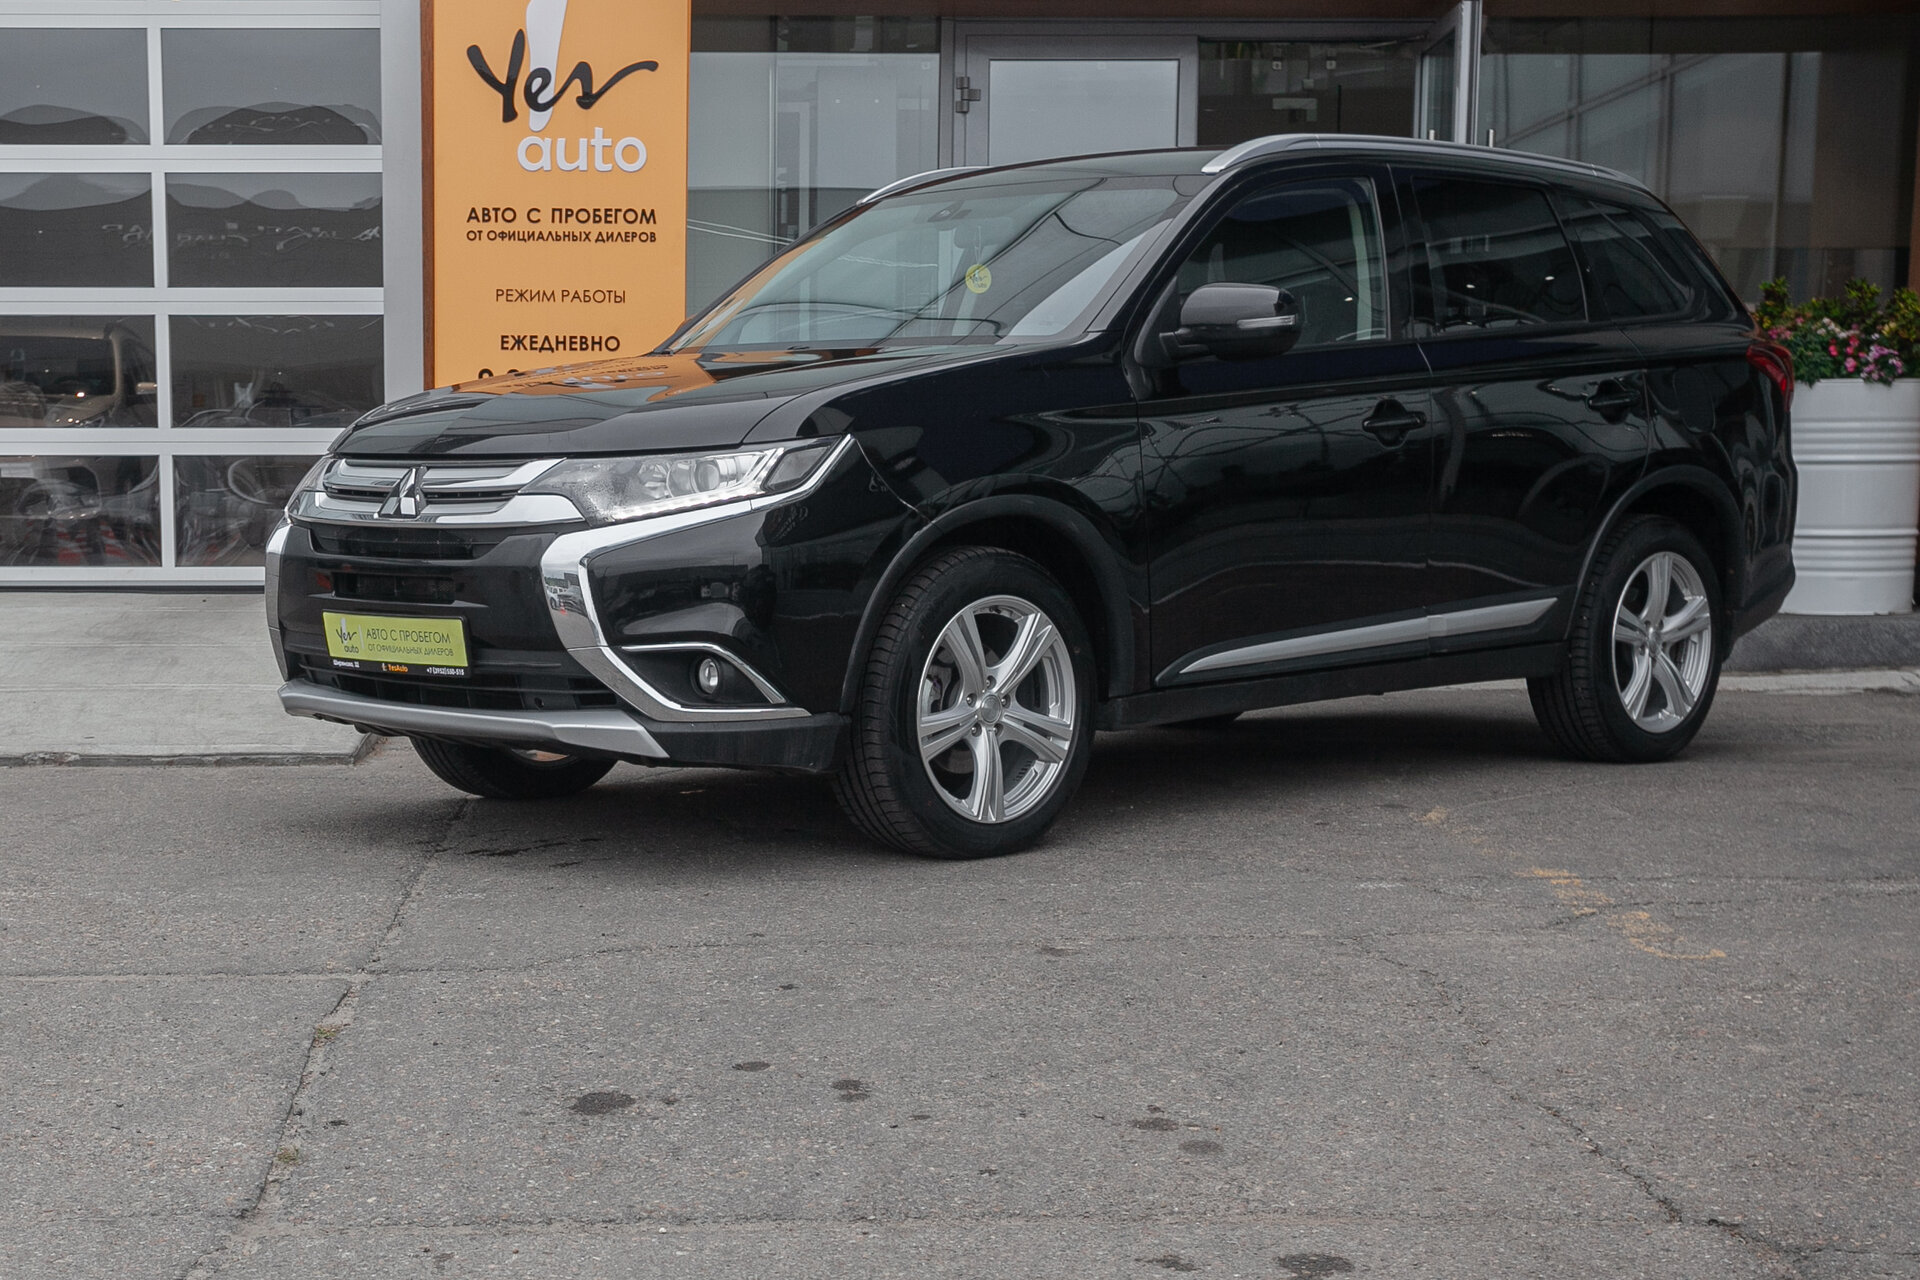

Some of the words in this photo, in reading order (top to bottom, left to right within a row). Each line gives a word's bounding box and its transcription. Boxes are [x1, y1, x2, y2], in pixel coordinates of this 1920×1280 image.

[466, 28, 659, 123] Yes
[517, 127, 648, 173] auto
[466, 207, 517, 224] АВТО
[526, 207, 541, 224] С
[551, 208, 657, 225] ПРОБЕГОМ
[466, 230, 483, 242] ОТ
[486, 230, 592, 243] ОФИЦИАЛЬНЫХ
[595, 231, 657, 243] ДИЛЕРОВ
[495, 288, 556, 303] РЕЖИМ
[561, 289, 626, 304] РАБОТЫ
[500, 335, 621, 353] ЕЖЕДНЕВНО
[366, 628, 388, 641] АВТО
[390, 629, 397, 641] С
[399, 630, 451, 644] ПРОБЕГОМ
[344, 645, 360, 654] auto
[424, 647, 454, 657] ДИЛЕРОВ
